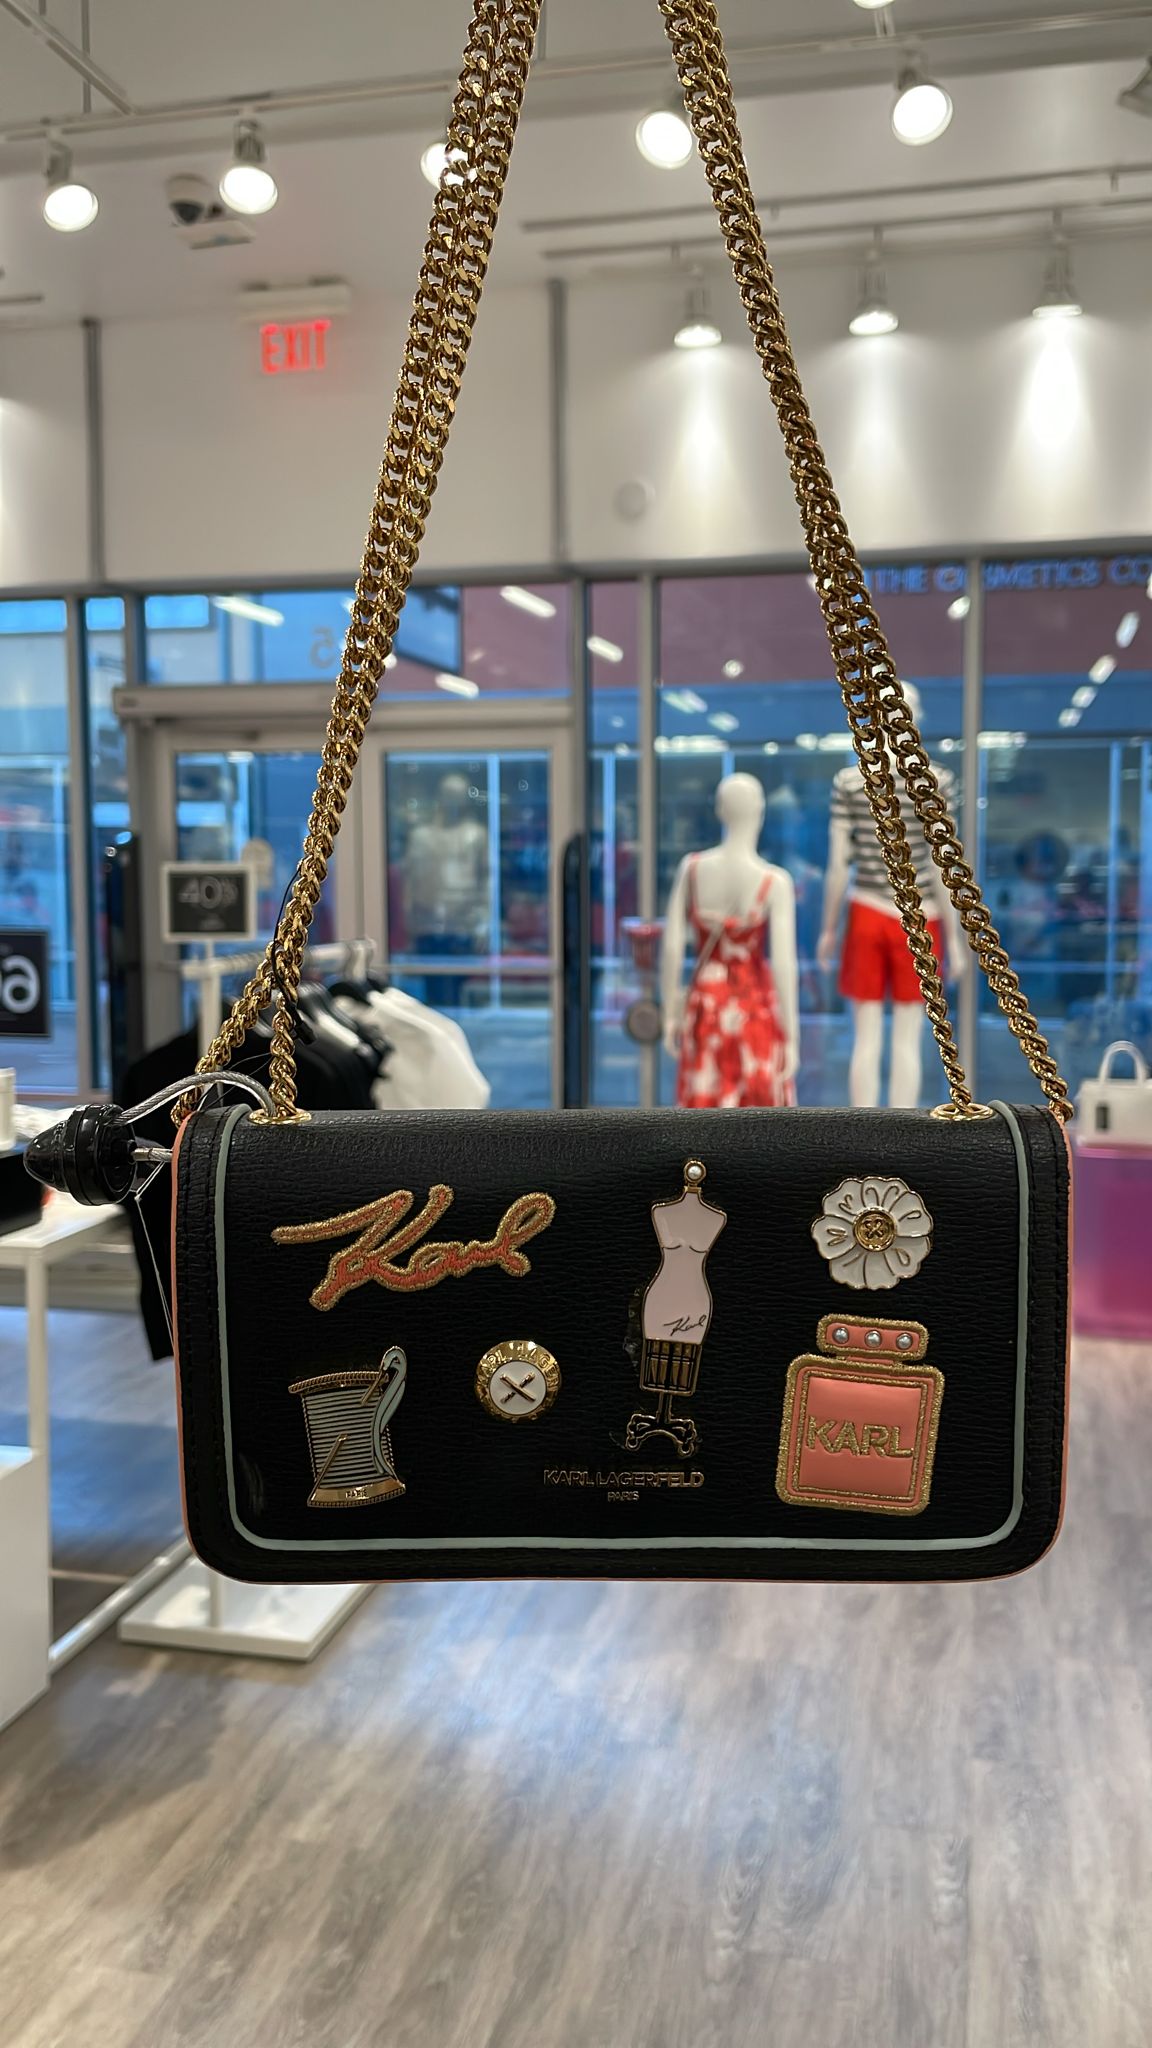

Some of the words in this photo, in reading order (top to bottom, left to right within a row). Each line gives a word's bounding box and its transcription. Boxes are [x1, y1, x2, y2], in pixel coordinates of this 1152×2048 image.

[259, 318, 331, 374] EXIT
[271, 1184, 556, 1311] Karl
[663, 1314, 707, 1336] Karl
[806, 1415, 914, 1457] KARL
[543, 1469, 595, 1487] KARL
[596, 1471, 704, 1488] LAGERFELD
[607, 1490, 640, 1502] PARIS
